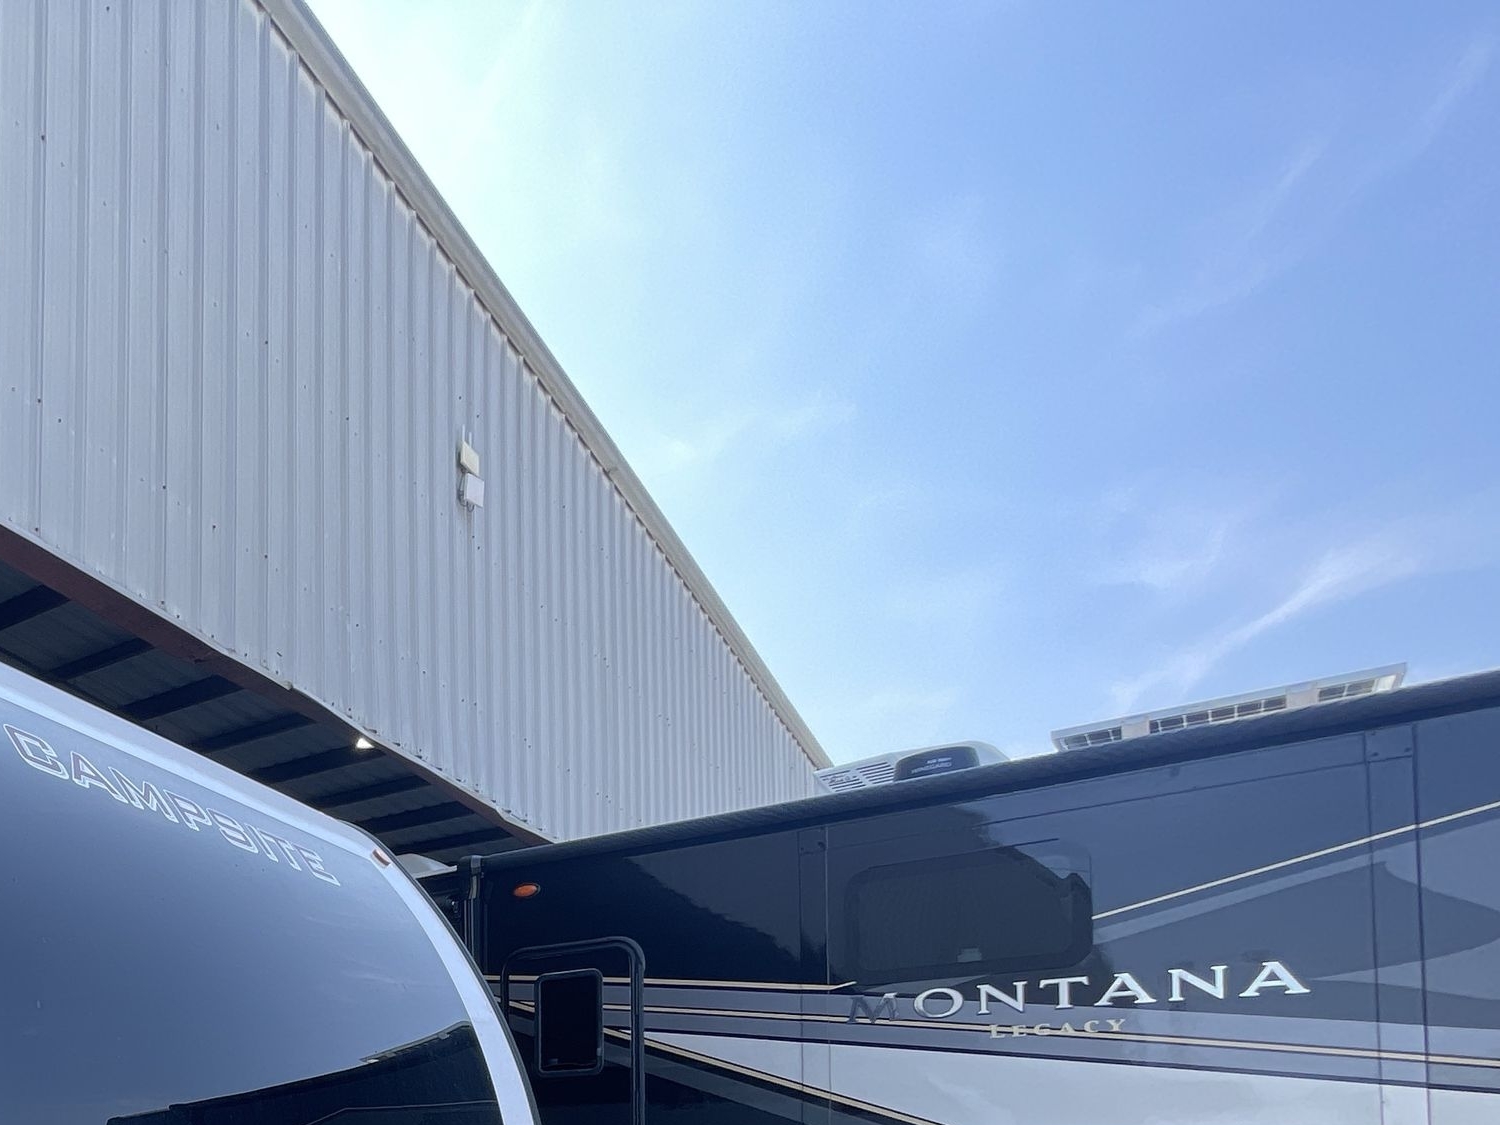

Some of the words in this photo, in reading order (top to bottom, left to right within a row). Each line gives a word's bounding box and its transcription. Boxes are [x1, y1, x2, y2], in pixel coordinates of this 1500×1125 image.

[2, 723, 341, 887] CAMPSITE
[846, 960, 1312, 1025] MONTANA
[989, 1017, 1127, 1040] LEGACY
